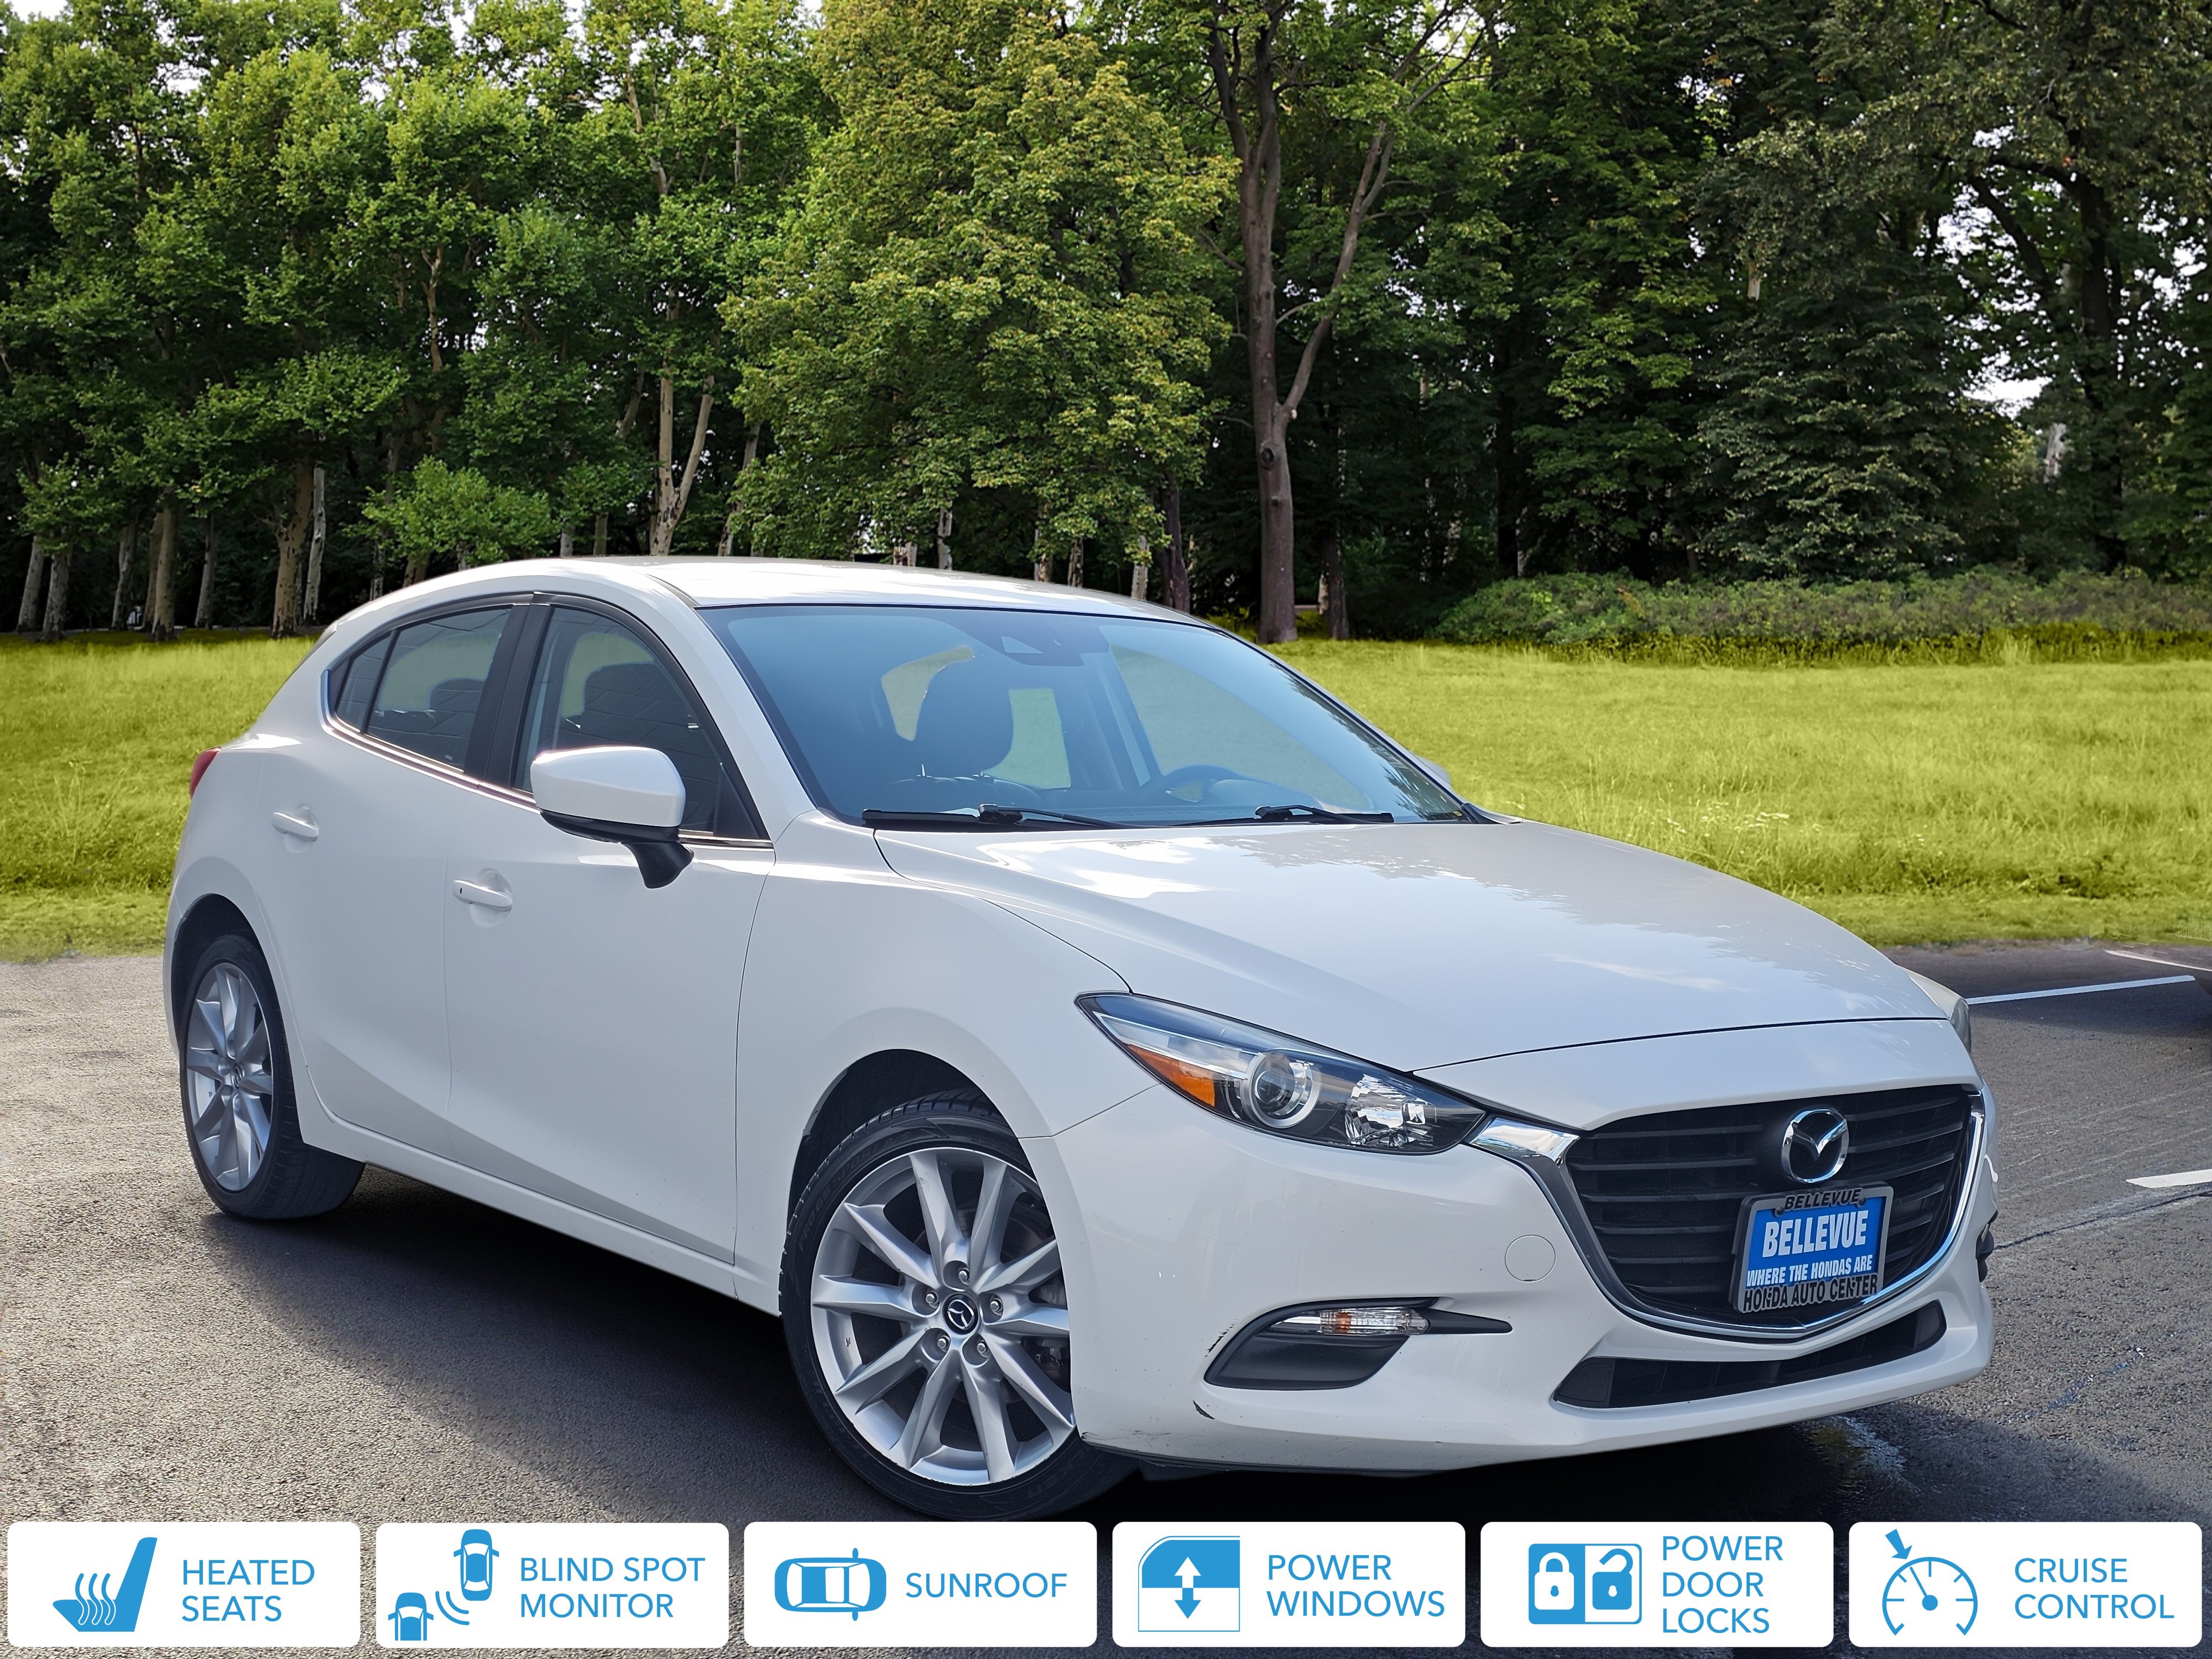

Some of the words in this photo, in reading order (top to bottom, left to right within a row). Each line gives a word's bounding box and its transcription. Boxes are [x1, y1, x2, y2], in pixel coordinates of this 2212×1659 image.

[1785, 1189, 1861, 1209] BELLEVUE
[1762, 1210, 1869, 1258] BELLEVUE
[1746, 1266, 1786, 1287] WHERE
[1789, 1264, 1809, 1282] THE
[1811, 1258, 1851, 1280] HONDAS
[1854, 1254, 1873, 1272] ARE
[1744, 1287, 1788, 1311] HONDA
[1792, 1281, 1825, 1305] AUTO
[1830, 1275, 1877, 1300] CENTER
